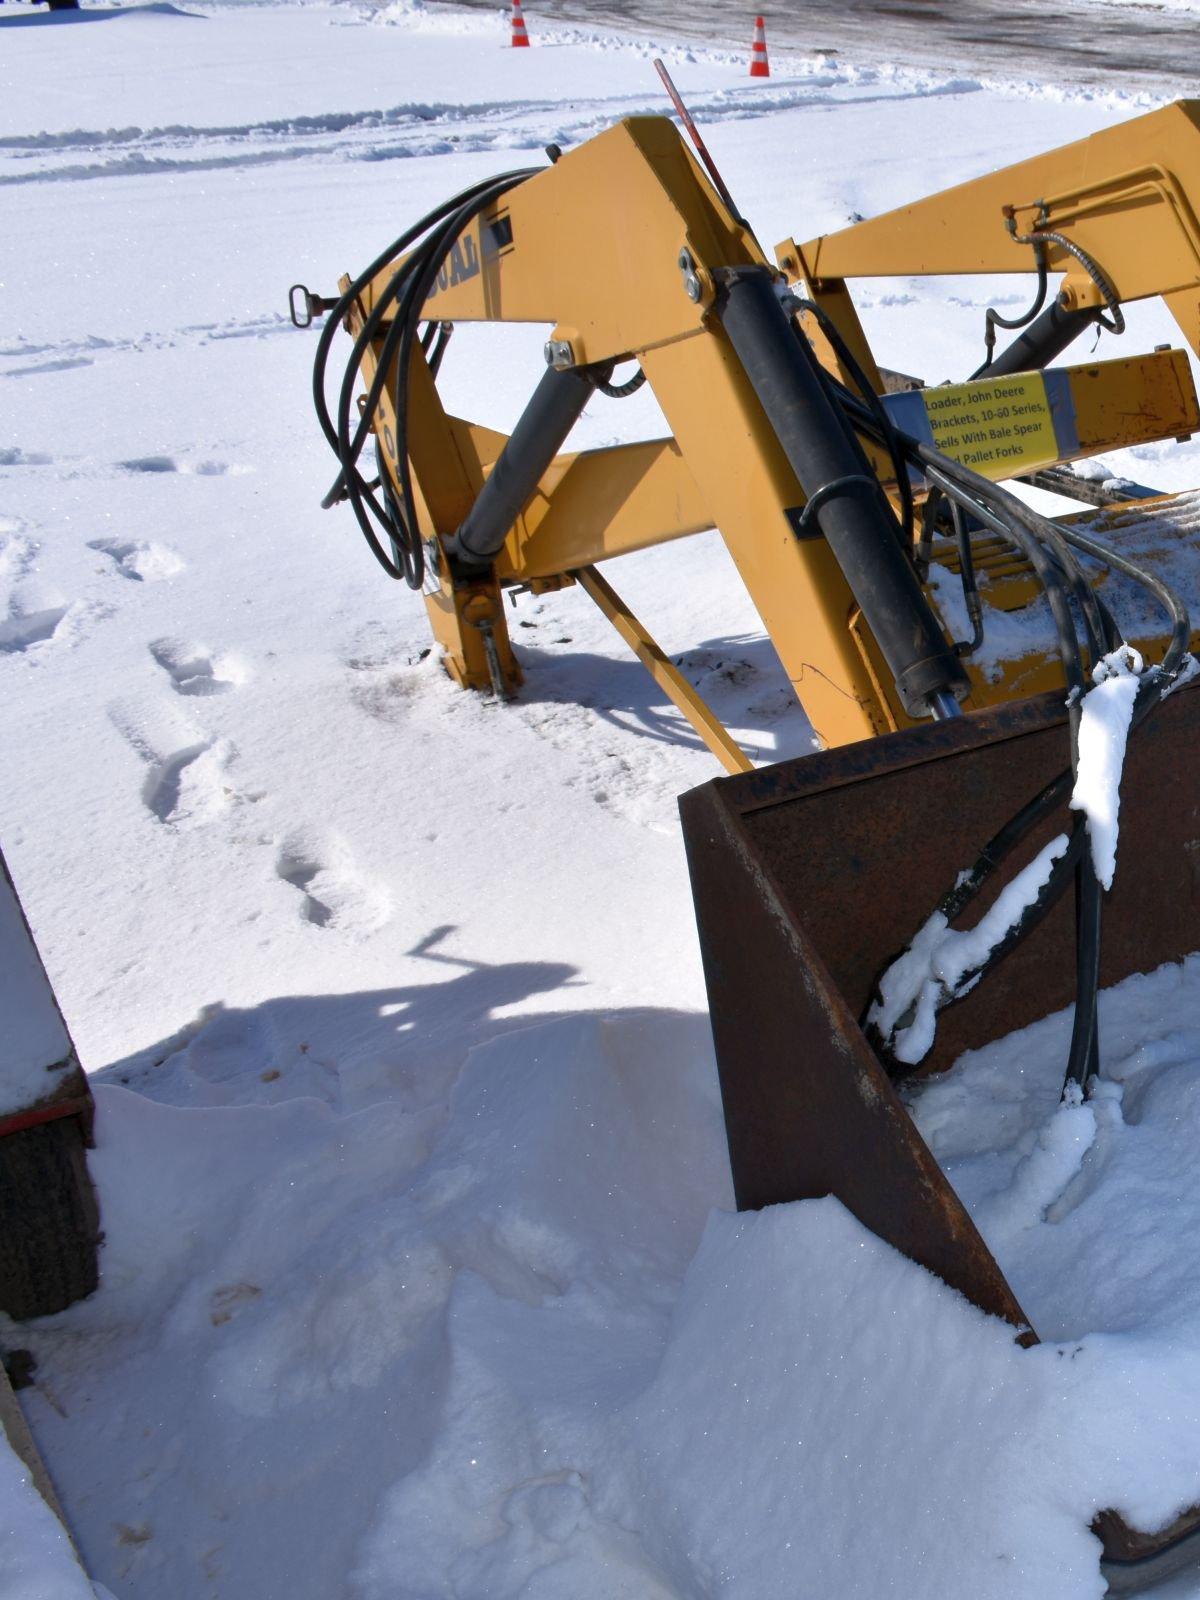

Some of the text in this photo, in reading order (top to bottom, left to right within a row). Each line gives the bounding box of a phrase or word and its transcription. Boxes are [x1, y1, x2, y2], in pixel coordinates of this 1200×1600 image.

[925, 385, 1025, 411] Loader, John Deere
[930, 415, 980, 430] Brackets,
[982, 407, 1010, 421] 10-60
[935, 422, 1042, 450] Sells With Bale Spear
[964, 450, 993, 465] Pallet
[996, 444, 1024, 460] Forks
